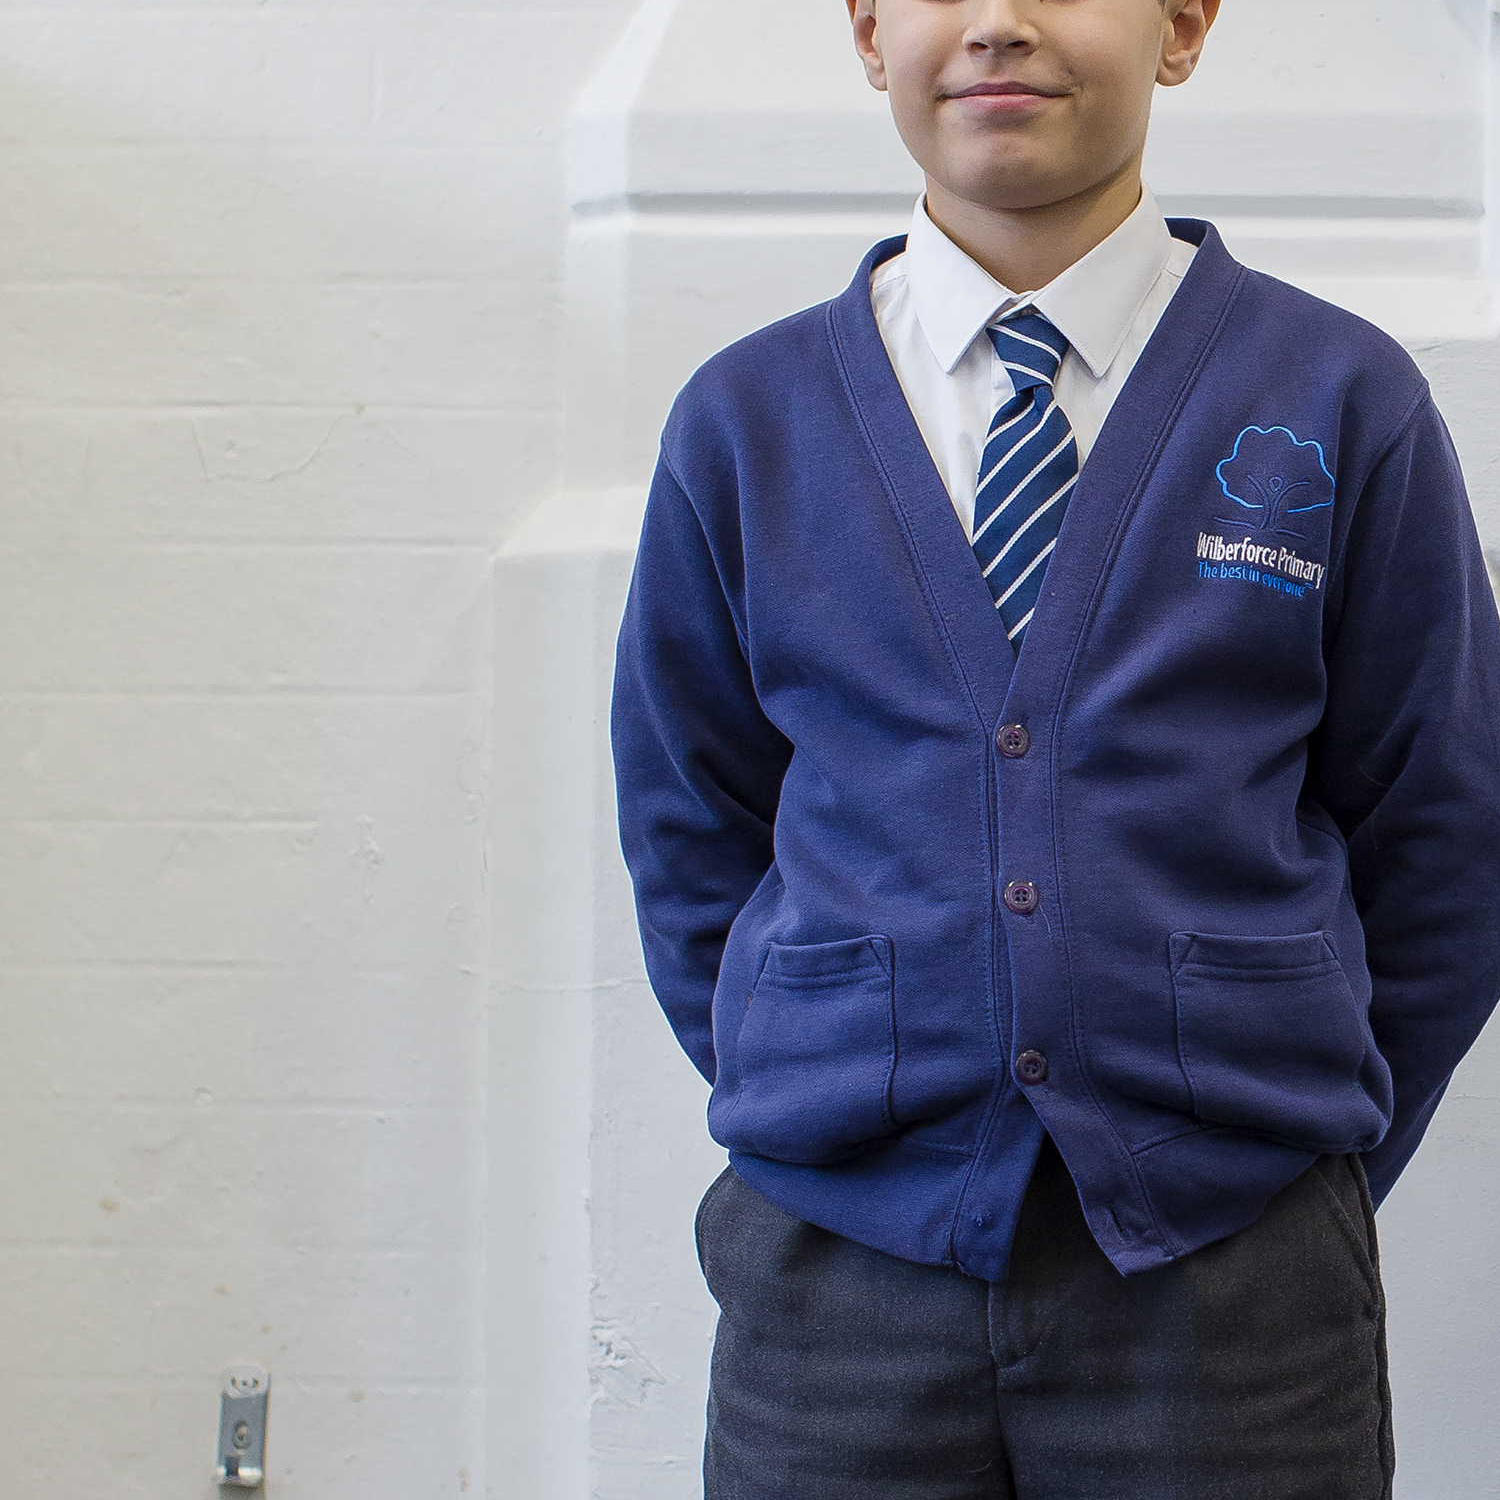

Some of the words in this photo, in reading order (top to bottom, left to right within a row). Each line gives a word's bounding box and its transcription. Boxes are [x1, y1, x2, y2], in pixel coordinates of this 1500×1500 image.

[1196, 532, 1277, 568] Wilberforce
[1278, 546, 1326, 590] Primary
[1198, 561, 1218, 579] The
[1220, 562, 1247, 580] best
[1248, 565, 1261, 583] in
